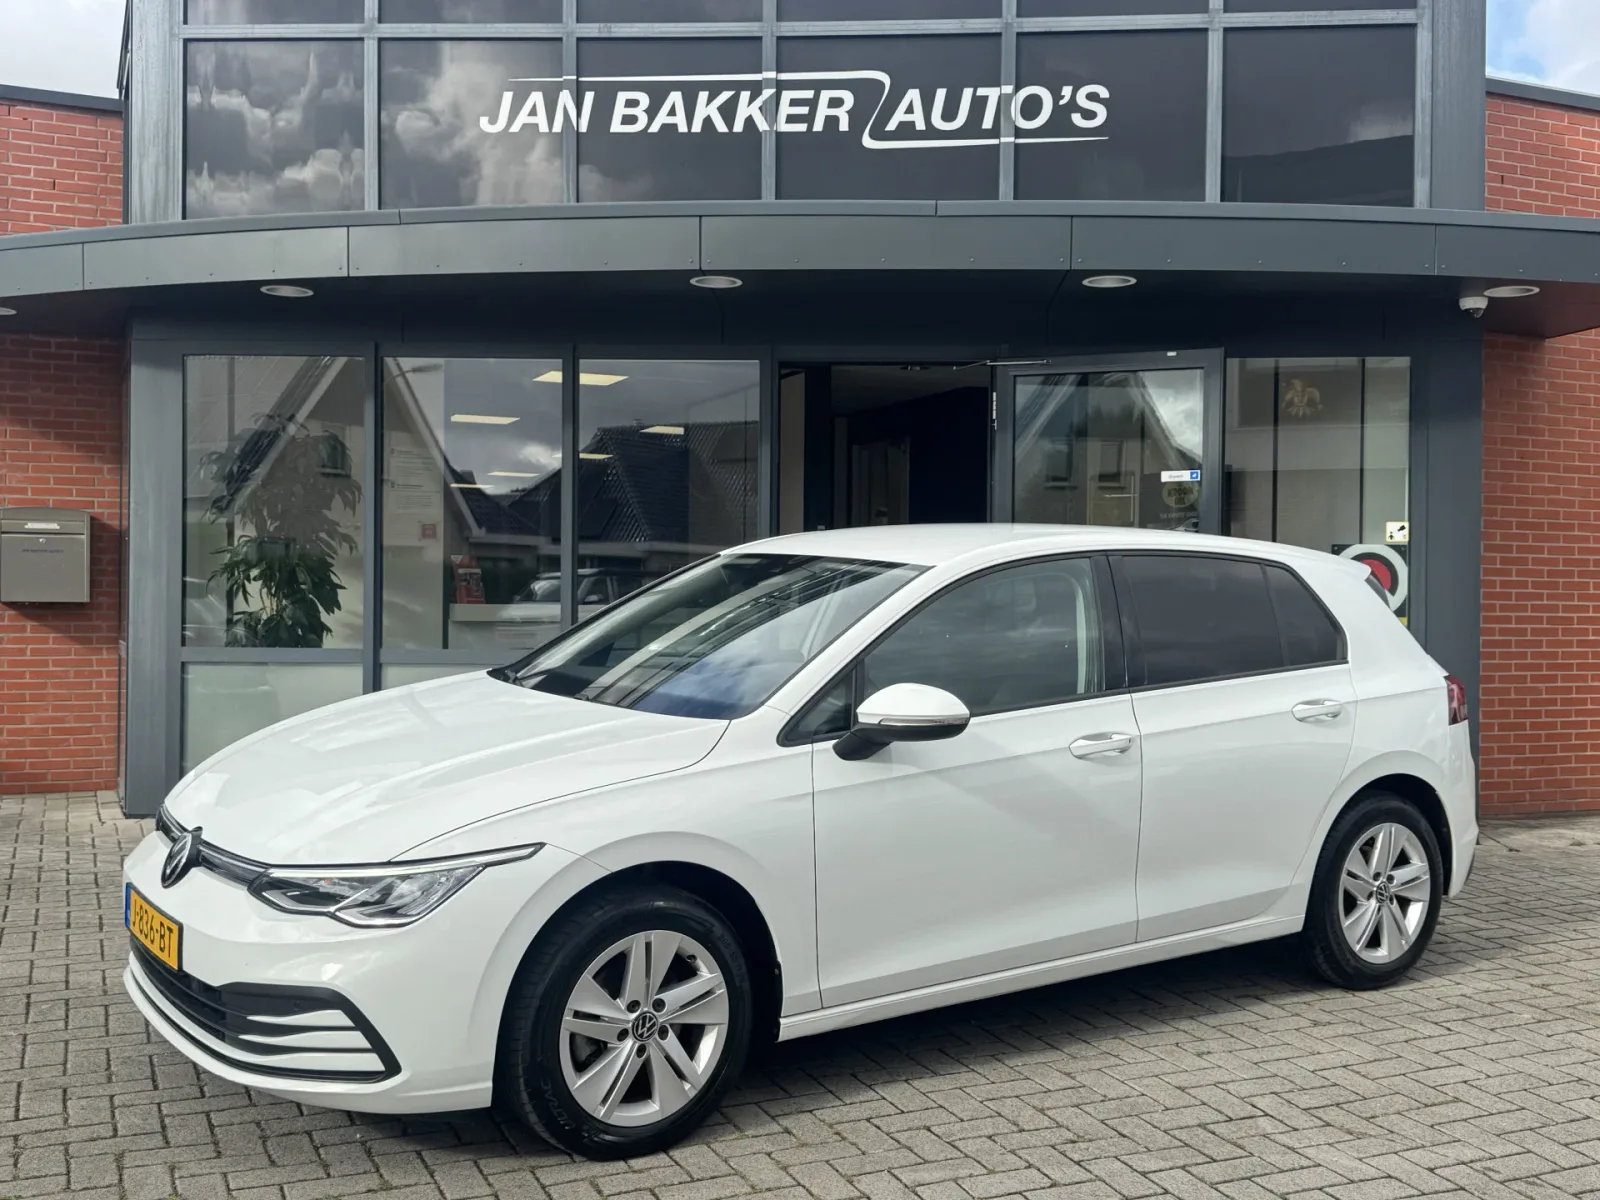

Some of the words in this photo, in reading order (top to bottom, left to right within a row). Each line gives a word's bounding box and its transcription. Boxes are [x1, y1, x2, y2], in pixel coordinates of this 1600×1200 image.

[479, 90, 595, 133] JAN
[608, 88, 855, 133] BAKKER
[886, 85, 1110, 132] AUTO'S
[132, 899, 174, 958] J-836-BT
